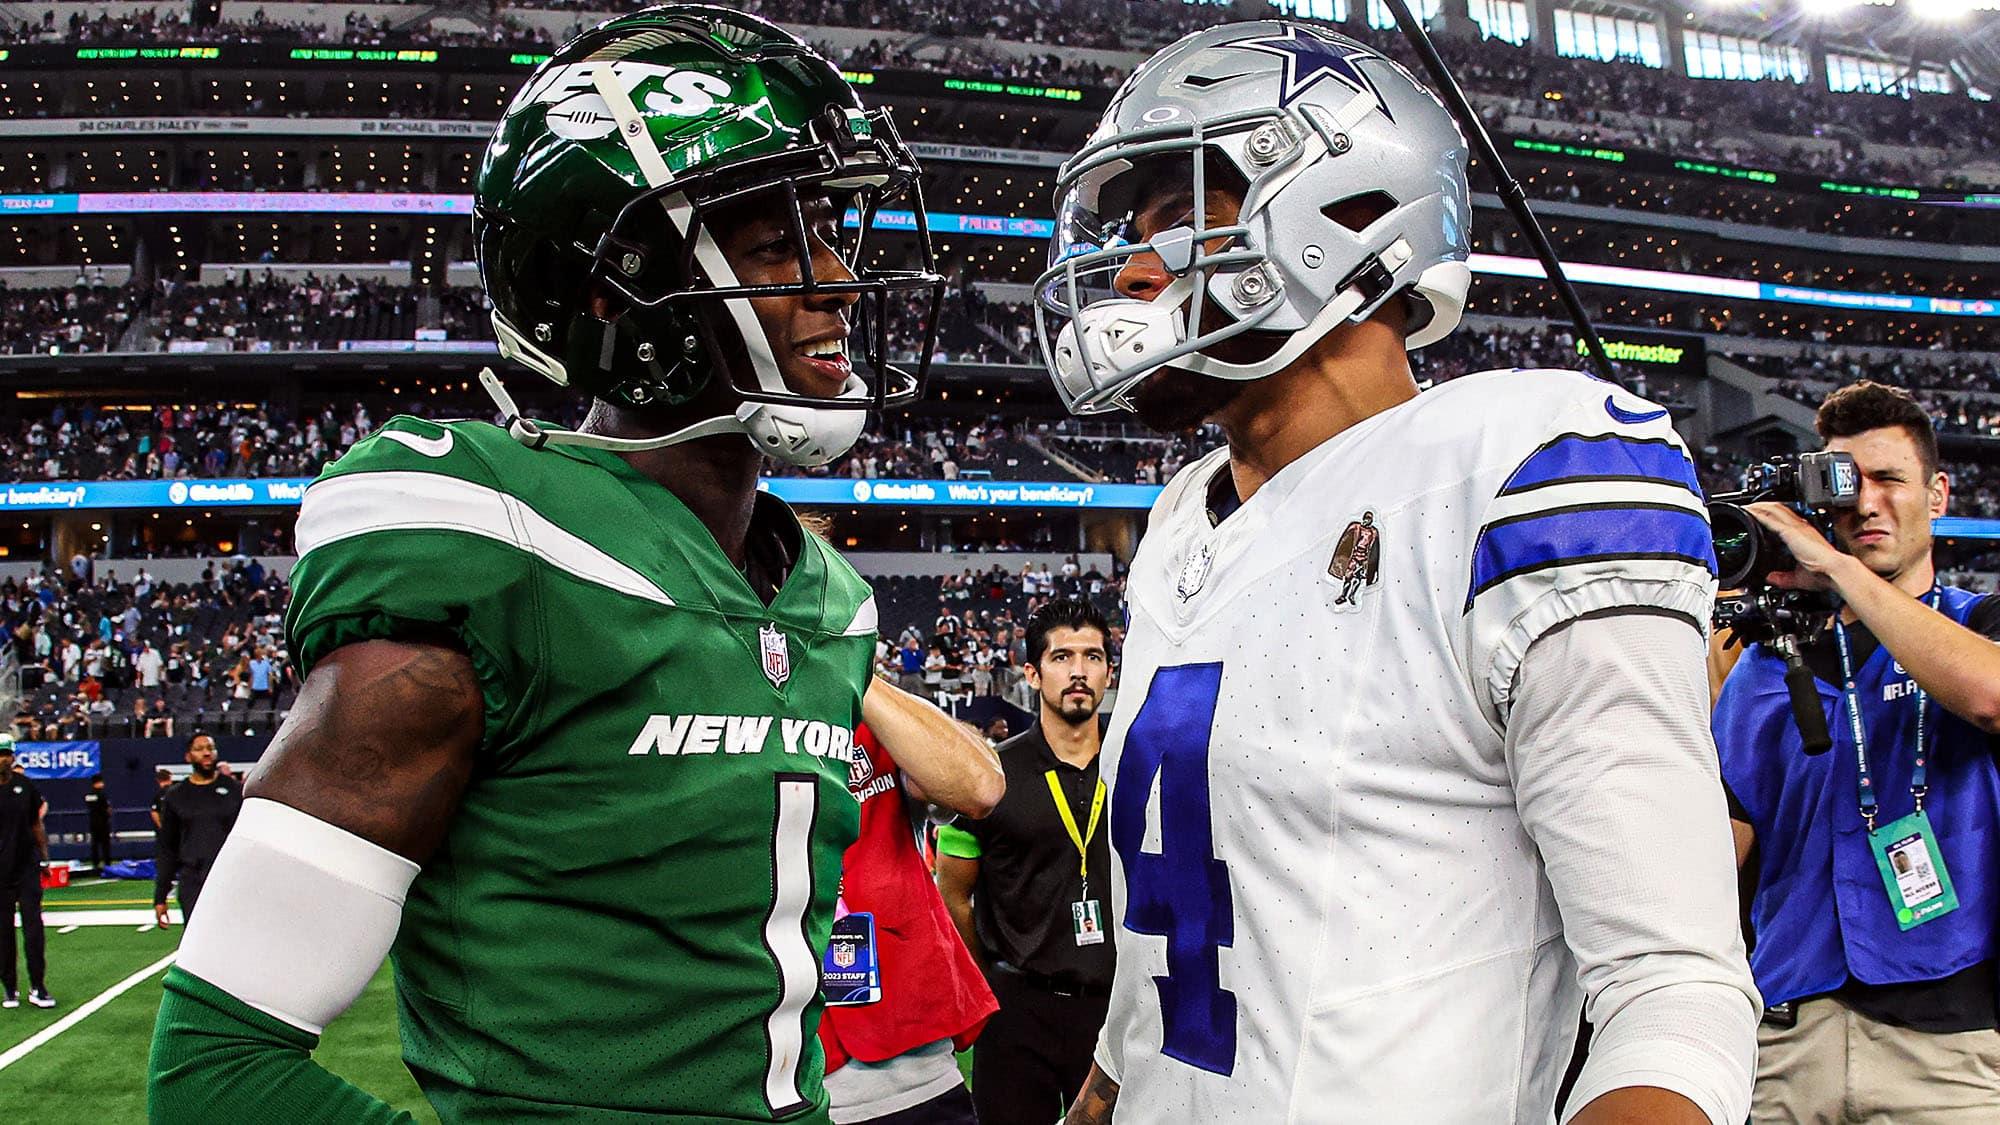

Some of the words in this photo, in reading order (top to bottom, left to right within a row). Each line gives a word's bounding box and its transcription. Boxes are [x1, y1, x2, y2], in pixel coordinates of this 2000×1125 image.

[97, 120, 154, 131] CHARLES
[157, 120, 199, 131] HALEY
[380, 122, 433, 132] MICHAEL
[960, 147, 997, 160] SMITH
[8, 486, 86, 507] beneficiary?
[949, 484, 987, 501] Who's
[989, 488, 1017, 504] your
[1020, 486, 1094, 506] beneficiary?
[768, 651, 787, 675] NFL
[1883, 683, 1905, 701] NFL
[628, 714, 774, 756] NEW
[16, 751, 51, 769] CBS
[58, 750, 95, 768] NFL
[854, 772, 896, 803] VISION
[1112, 661, 1238, 1078] 4
[761, 772, 820, 1119] 1
[836, 952, 852, 965] NFL
[823, 972, 841, 980] 2023
[842, 972, 866, 980] STAFF
